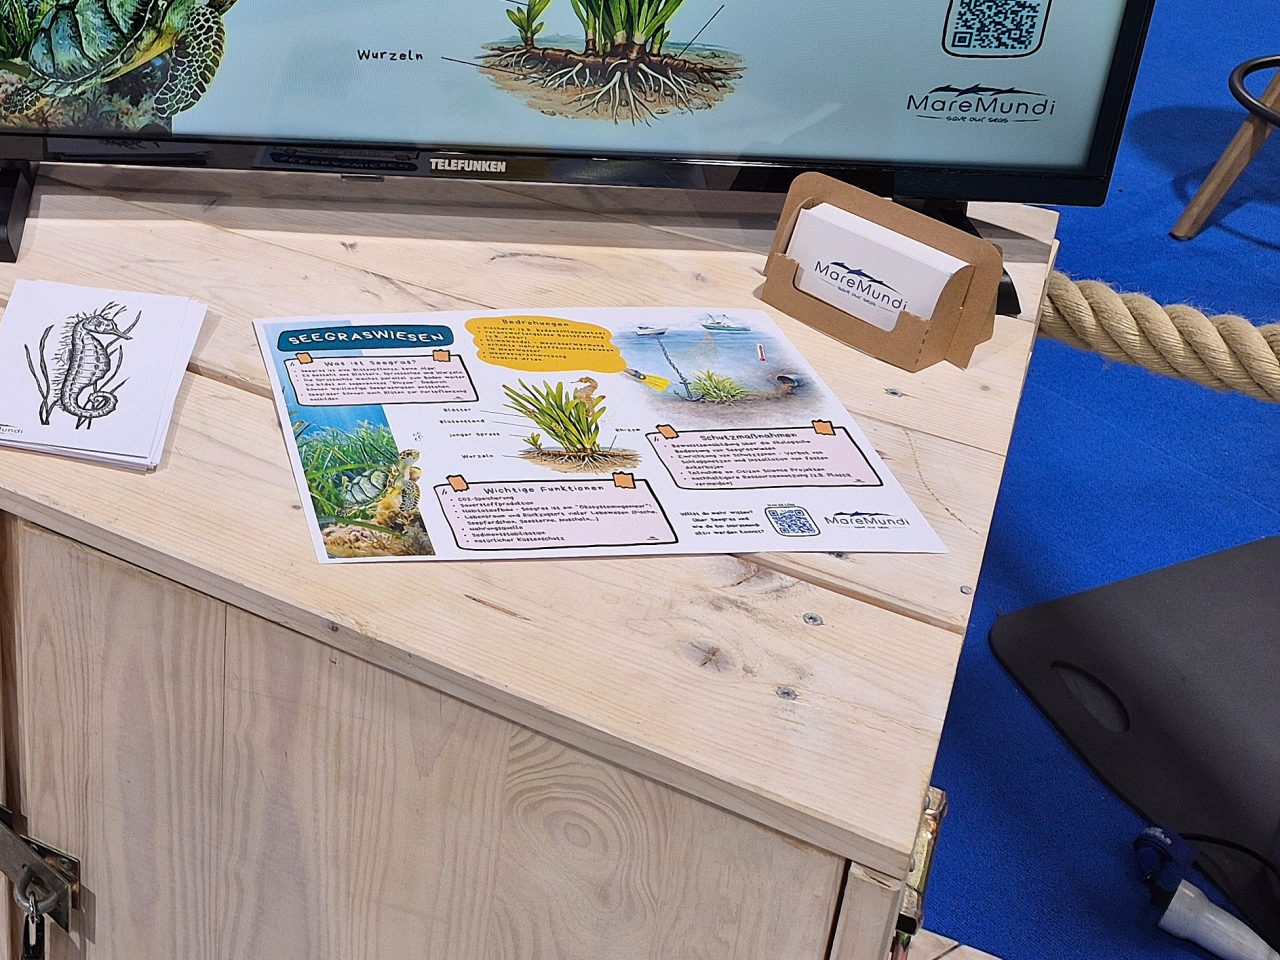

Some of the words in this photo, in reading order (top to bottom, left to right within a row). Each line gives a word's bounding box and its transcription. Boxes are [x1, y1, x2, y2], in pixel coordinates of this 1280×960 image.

[357, 48, 423, 61] Wurzeln
[906, 94, 1056, 116] MareMundi
[429, 158, 506, 172] TELEFUNKEN
[814, 260, 909, 311] MareMundi
[501, 319, 570, 328] Bedrohungen
[288, 329, 444, 345] SEEGRASWIESEN
[699, 432, 798, 441] Schutzmaßnahmen
[483, 486, 535, 495] Wichtige
[539, 485, 604, 493] Funktionen
[824, 516, 910, 525] MareMundi
